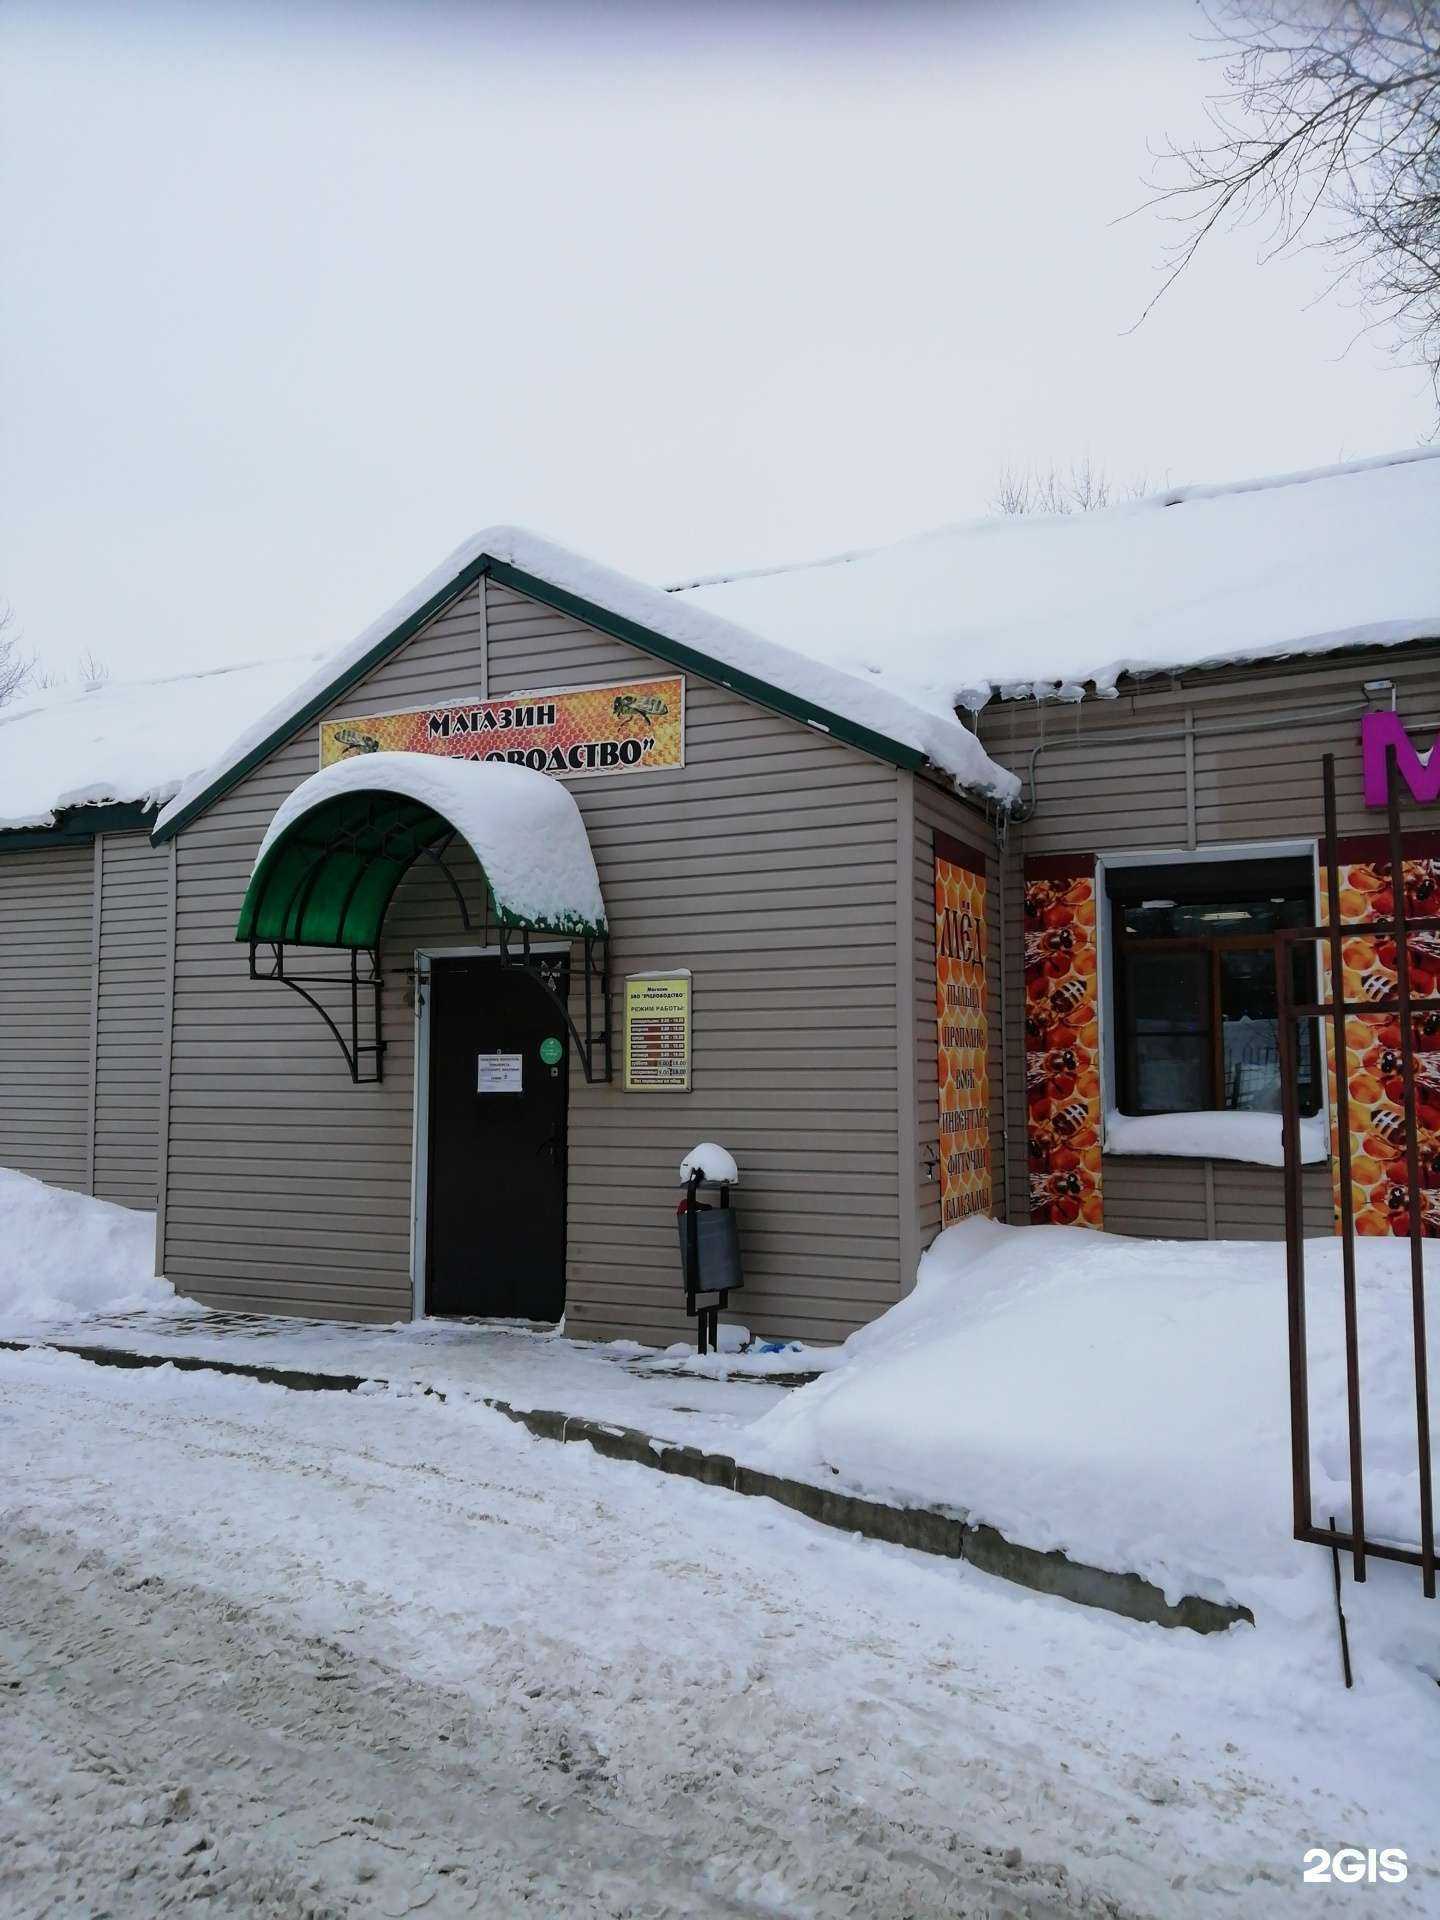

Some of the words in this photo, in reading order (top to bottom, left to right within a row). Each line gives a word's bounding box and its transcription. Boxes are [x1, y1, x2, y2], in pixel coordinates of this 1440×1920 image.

[428, 704, 555, 738] МАГАЗИН
[940, 900, 984, 970] МЁД
[943, 1026, 984, 1049] ПРОПОЛИС
[955, 1068, 976, 1090] ВОСК
[942, 1108, 989, 1133] ИНВЕНТАРЬ
